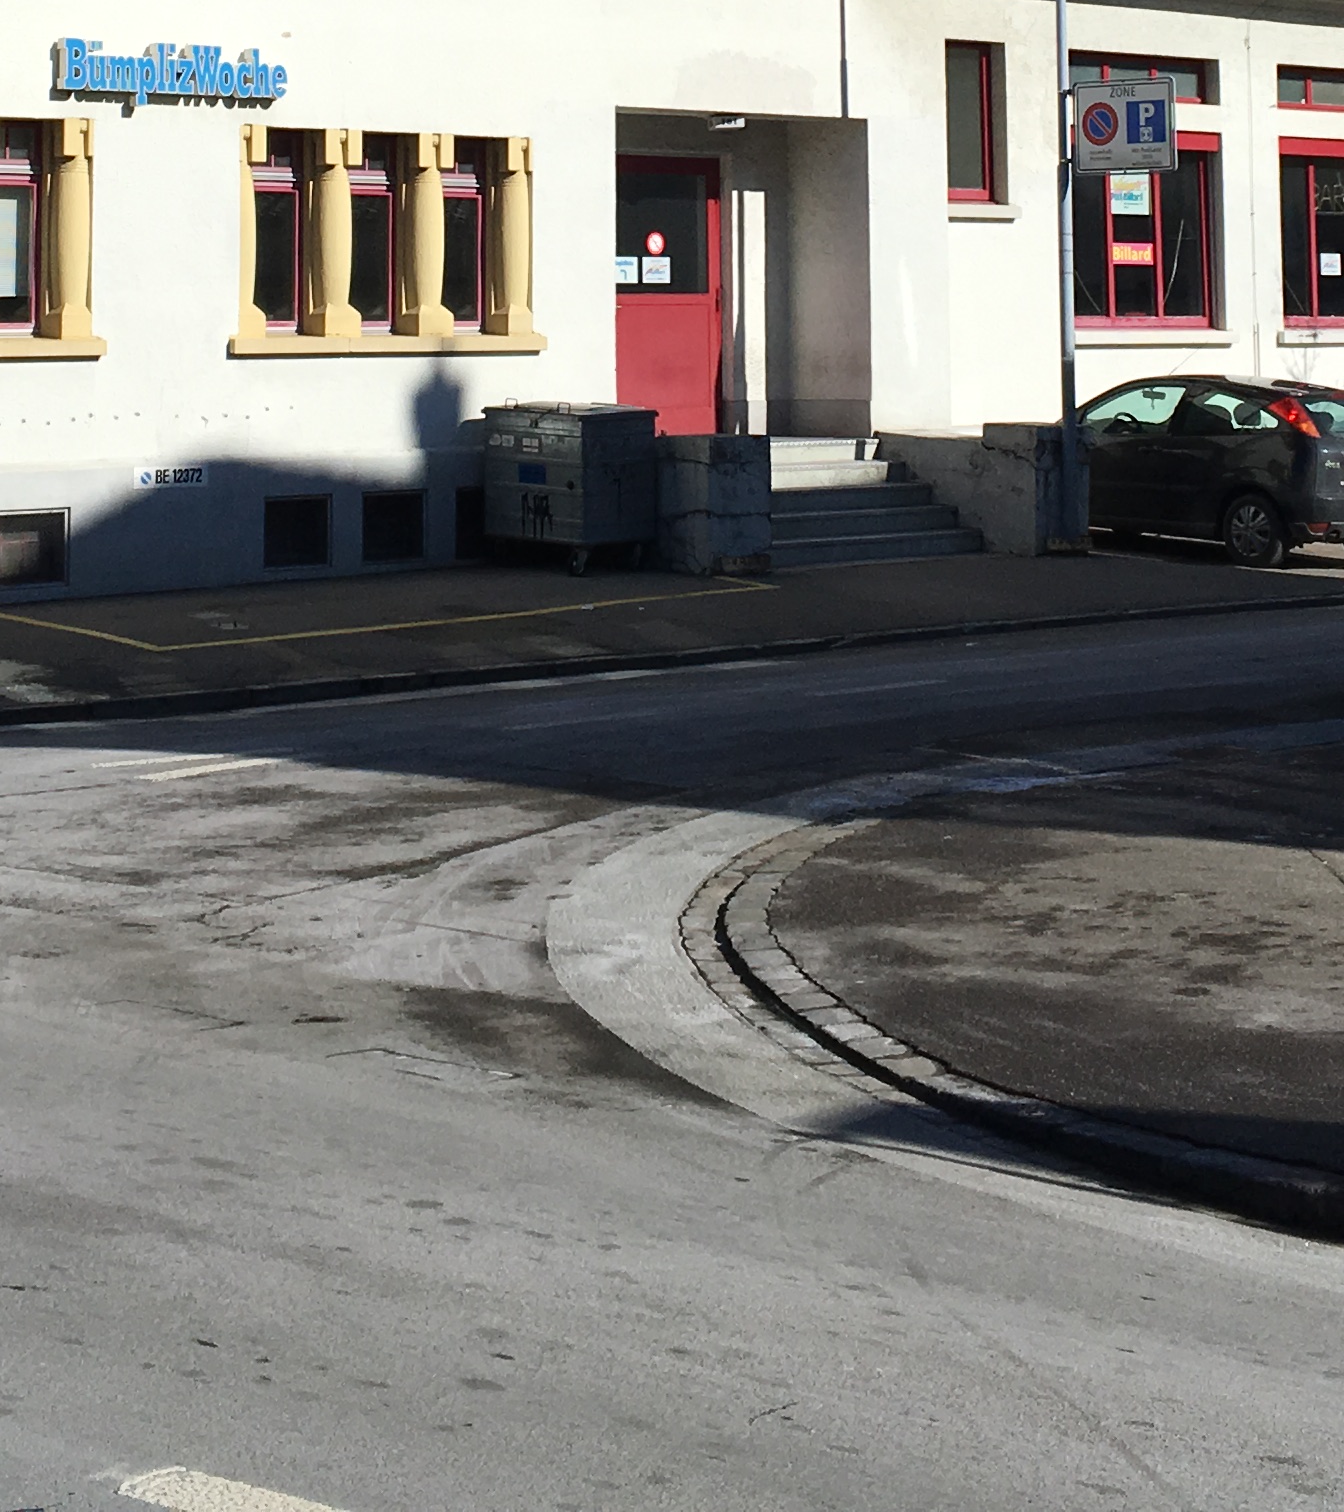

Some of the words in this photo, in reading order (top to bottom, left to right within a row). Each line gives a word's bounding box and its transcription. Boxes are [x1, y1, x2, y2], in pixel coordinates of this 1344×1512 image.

[57, 37, 288, 106] BümplizWoche
[1109, 86, 1136, 98] ZONE
[1138, 102, 1155, 126] P
[1112, 245, 1152, 262] Billard
[155, 469, 170, 485] BE
[172, 468, 204, 484] 12372
